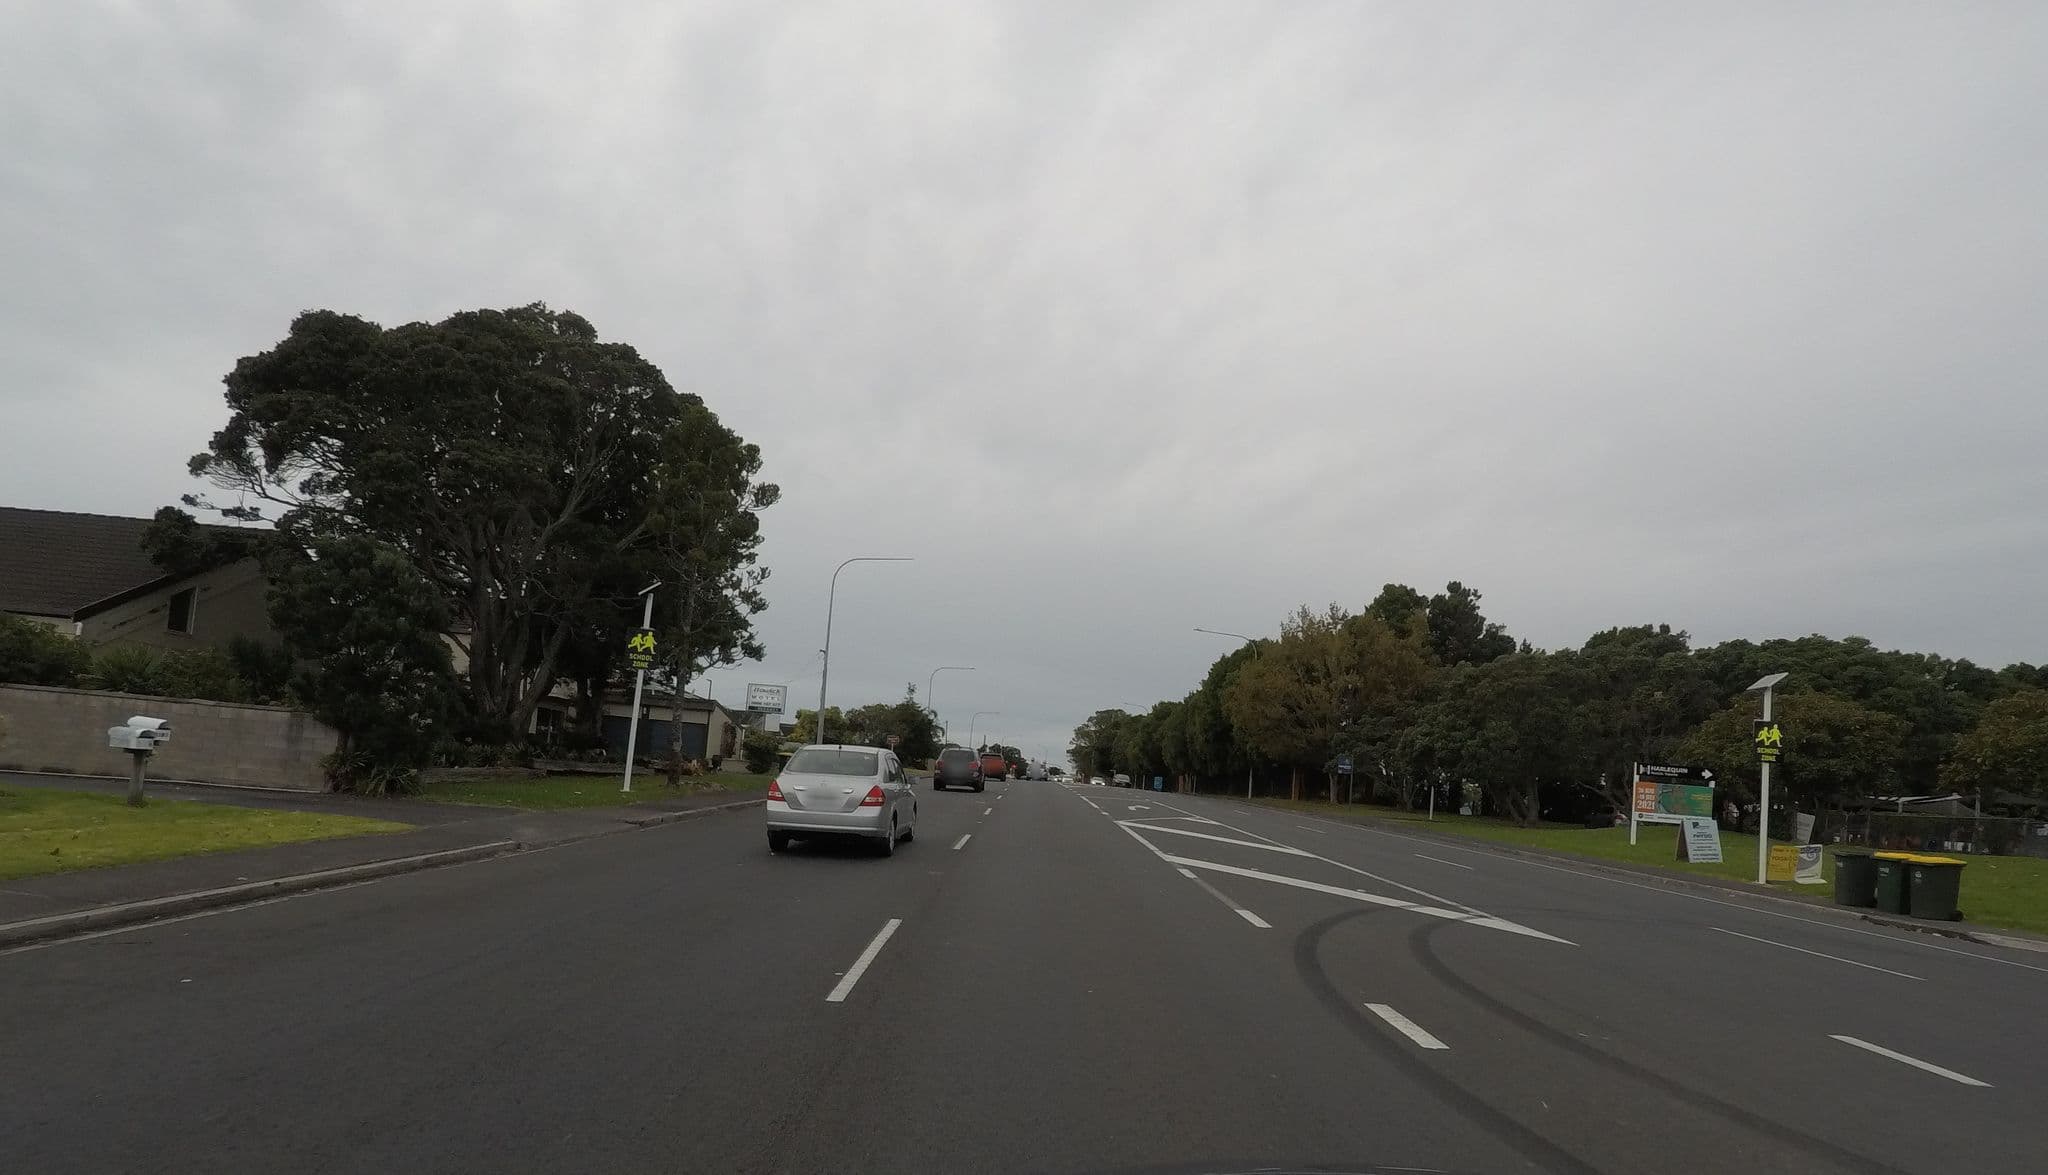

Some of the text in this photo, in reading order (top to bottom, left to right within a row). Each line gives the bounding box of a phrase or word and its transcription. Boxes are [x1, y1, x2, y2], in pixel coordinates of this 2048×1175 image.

[629, 653, 654, 661] SCHOOL
[1756, 747, 1781, 755] SCHOOL
[1761, 754, 1777, 762] ZONE
[1650, 765, 1689, 774] HARLEQUIN
[1636, 800, 1655, 810] 2021
